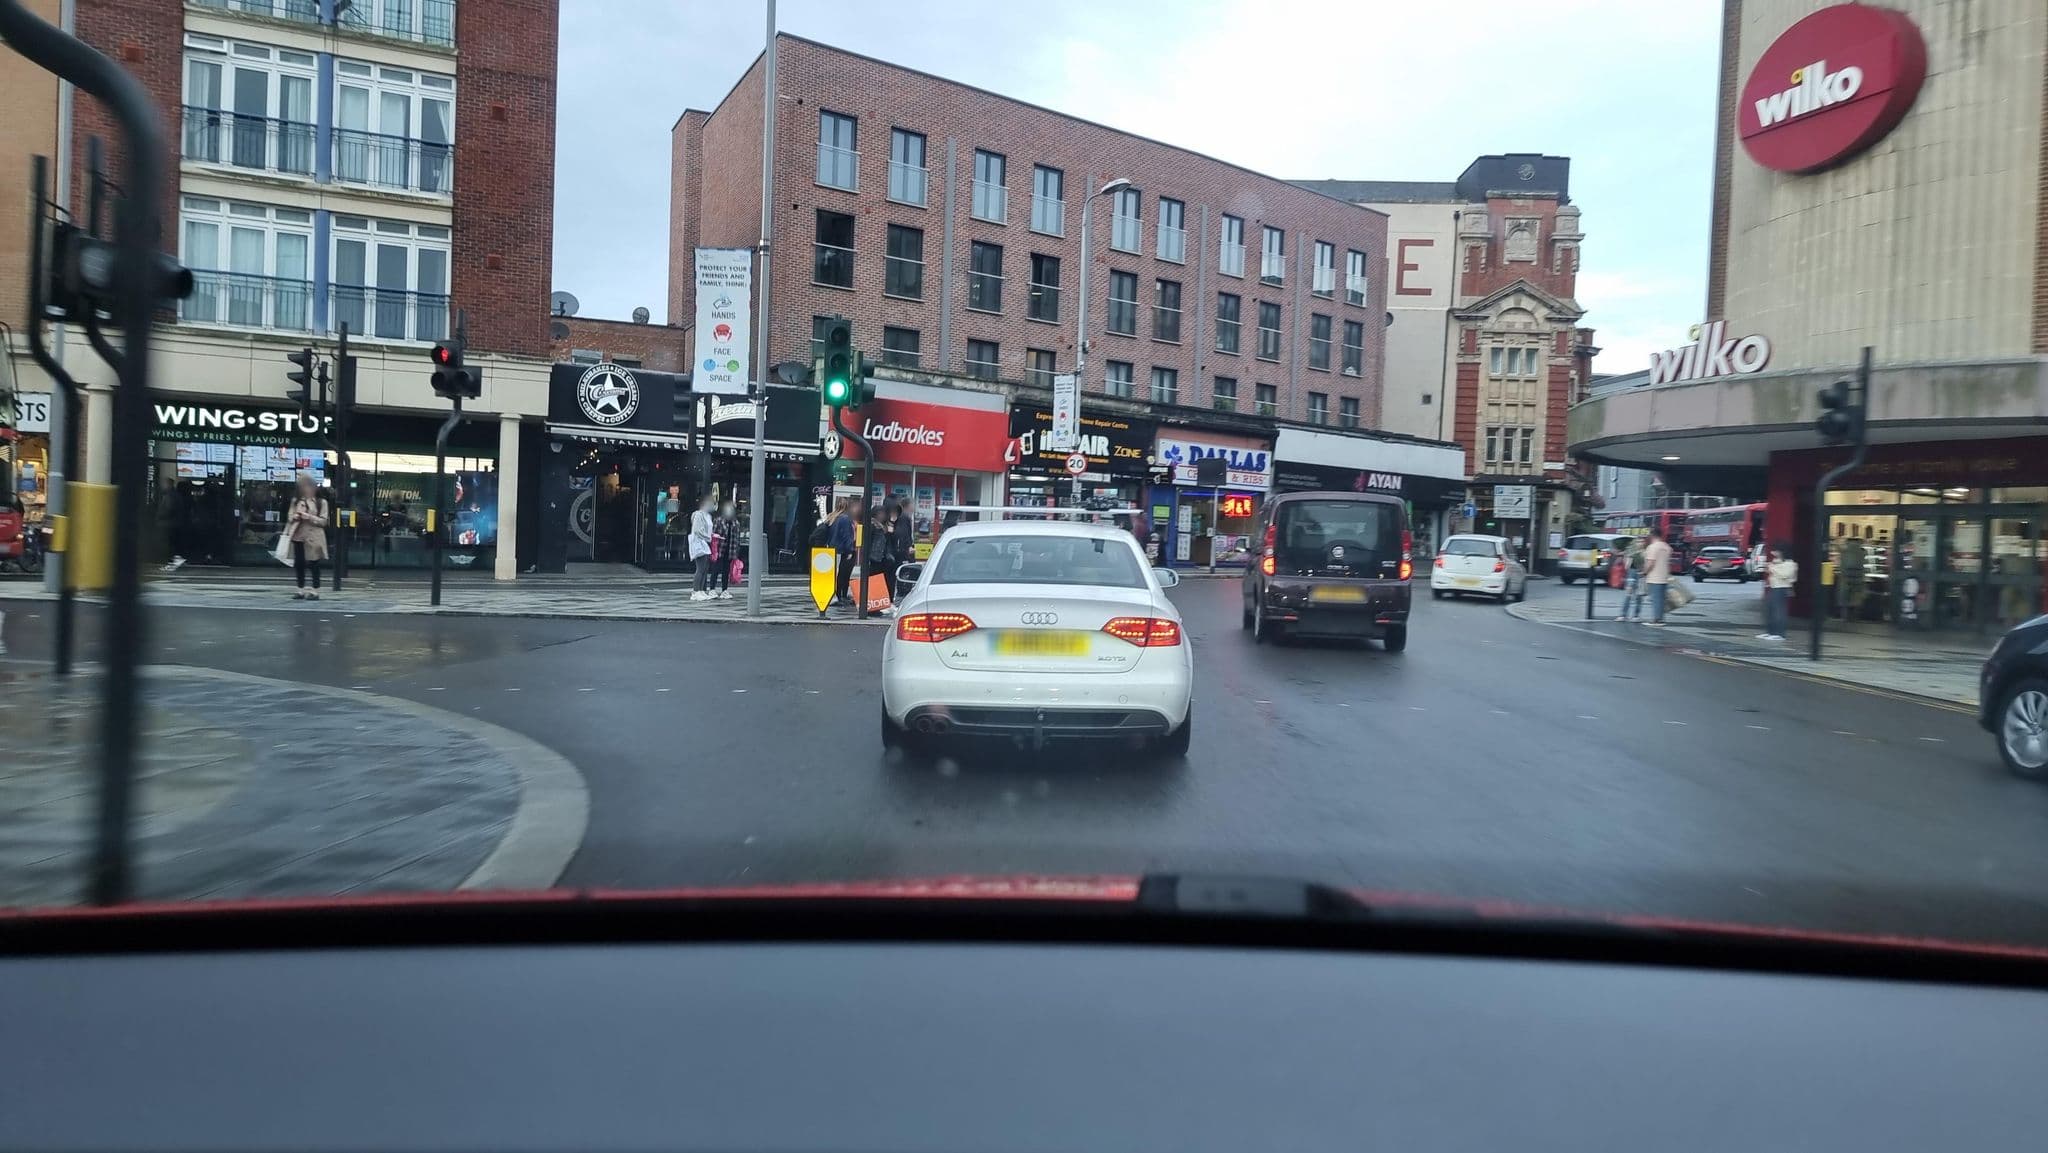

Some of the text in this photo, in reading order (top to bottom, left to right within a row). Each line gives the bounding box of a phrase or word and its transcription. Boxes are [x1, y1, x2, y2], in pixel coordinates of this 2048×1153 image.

[1755, 59, 1863, 128] wilko
[1396, 239, 1434, 295] E
[711, 311, 736, 320] HANDS
[713, 347, 732, 356] FACE
[1649, 320, 1770, 385] wilko
[709, 374, 732, 383] SPACE
[152, 430, 291, 445] WINGS FRIES FLAVOUR
[863, 418, 945, 447] Ladbrokes
[571, 435, 598, 444] THE
[730, 449, 788, 461] DESERT
[1069, 459, 1084, 469] 20
[1367, 473, 1402, 490] AYAN
